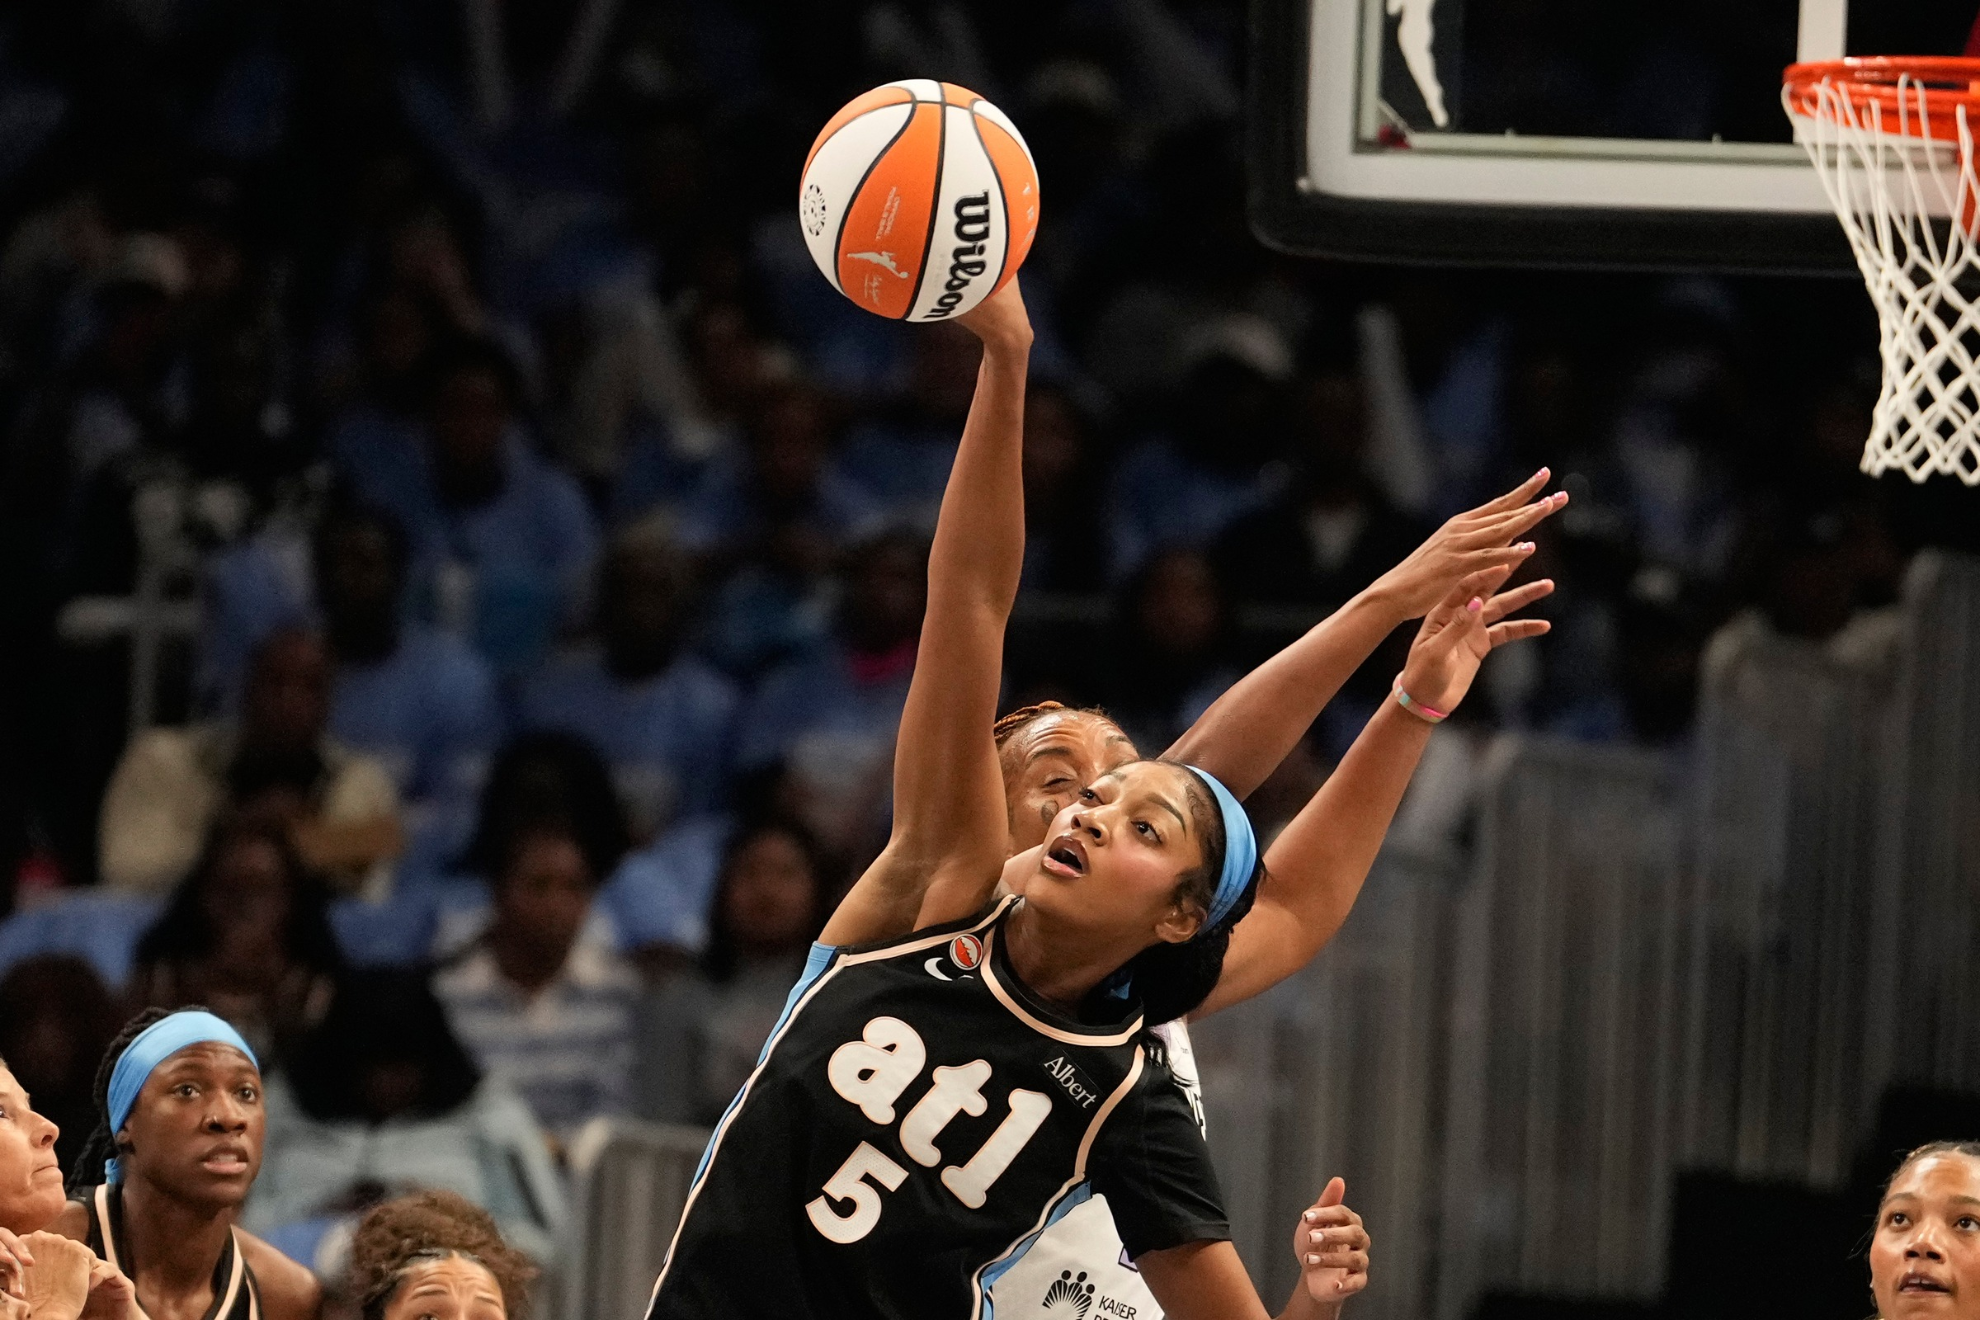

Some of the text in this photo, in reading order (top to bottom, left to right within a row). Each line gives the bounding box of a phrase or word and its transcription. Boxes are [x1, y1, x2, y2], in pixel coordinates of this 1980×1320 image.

[923, 188, 990, 319] Wilson
[828, 1016, 1053, 1210] atl
[1043, 1056, 1097, 1109] Albert
[805, 1140, 910, 1245] 5
[1098, 1295, 1137, 1320] KAISER
